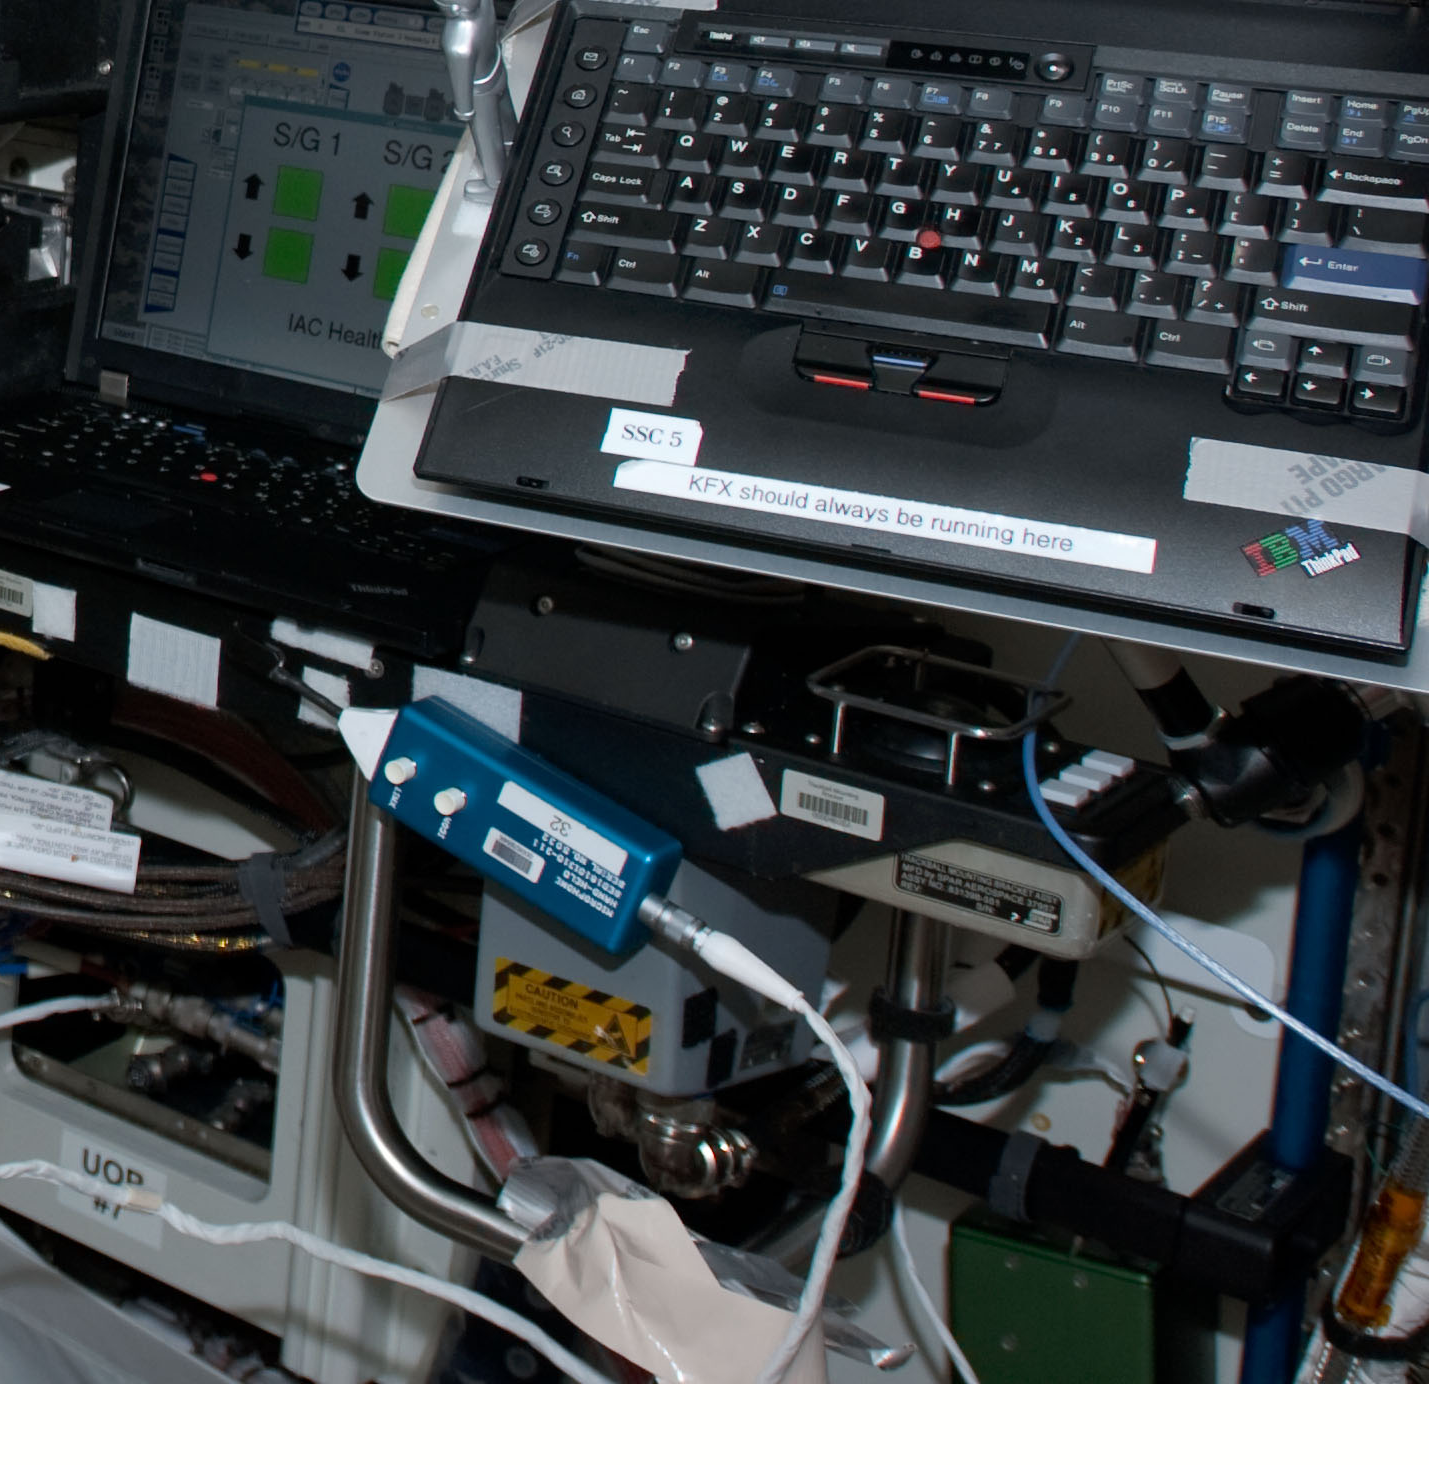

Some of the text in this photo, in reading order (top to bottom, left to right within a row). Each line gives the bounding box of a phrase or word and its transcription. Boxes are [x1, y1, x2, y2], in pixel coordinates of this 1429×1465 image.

[633, 25, 650, 34] Esc
[1106, 79, 1134, 89] PrtSc
[1211, 89, 1244, 100] Pause
[1292, 93, 1323, 105] Insert
[1347, 99, 1379, 111] Home
[1286, 122, 1319, 134] Delete
[1342, 127, 1364, 138] End
[273, 121, 342, 156] S/G 1
[605, 133, 621, 143] Tab
[1399, 132, 1429, 145] PgDn
[383, 139, 434, 171] S/G
[592, 172, 643, 185] Caps Lock
[1343, 171, 1403, 186] Backspace
[597, 213, 620, 224] Shift
[618, 258, 637, 269] Ctrl
[1327, 260, 1359, 273] Enter
[695, 269, 710, 279] Alt
[1280, 300, 1309, 313] Shift
[288, 312, 324, 336] IAC
[1069, 319, 1088, 330] Alt
[1159, 331, 1182, 342] Ctrl
[620, 423, 683, 448] SSC 5
[688, 474, 1073, 553] KFX should always be running here
[1243, 518, 1339, 577] IBM
[1299, 541, 1360, 577] ThinkPad
[549, 814, 573, 838] 32
[947, 865, 992, 885] MOUNTING
[993, 879, 1033, 897] BRACKET
[562, 869, 619, 909] HAND-HELD
[936, 872, 963, 886] SPAR
[964, 881, 1024, 906] AEROSPACE
[554, 875, 615, 918] MICROPHONE
[524, 982, 579, 1009] CAUTION
